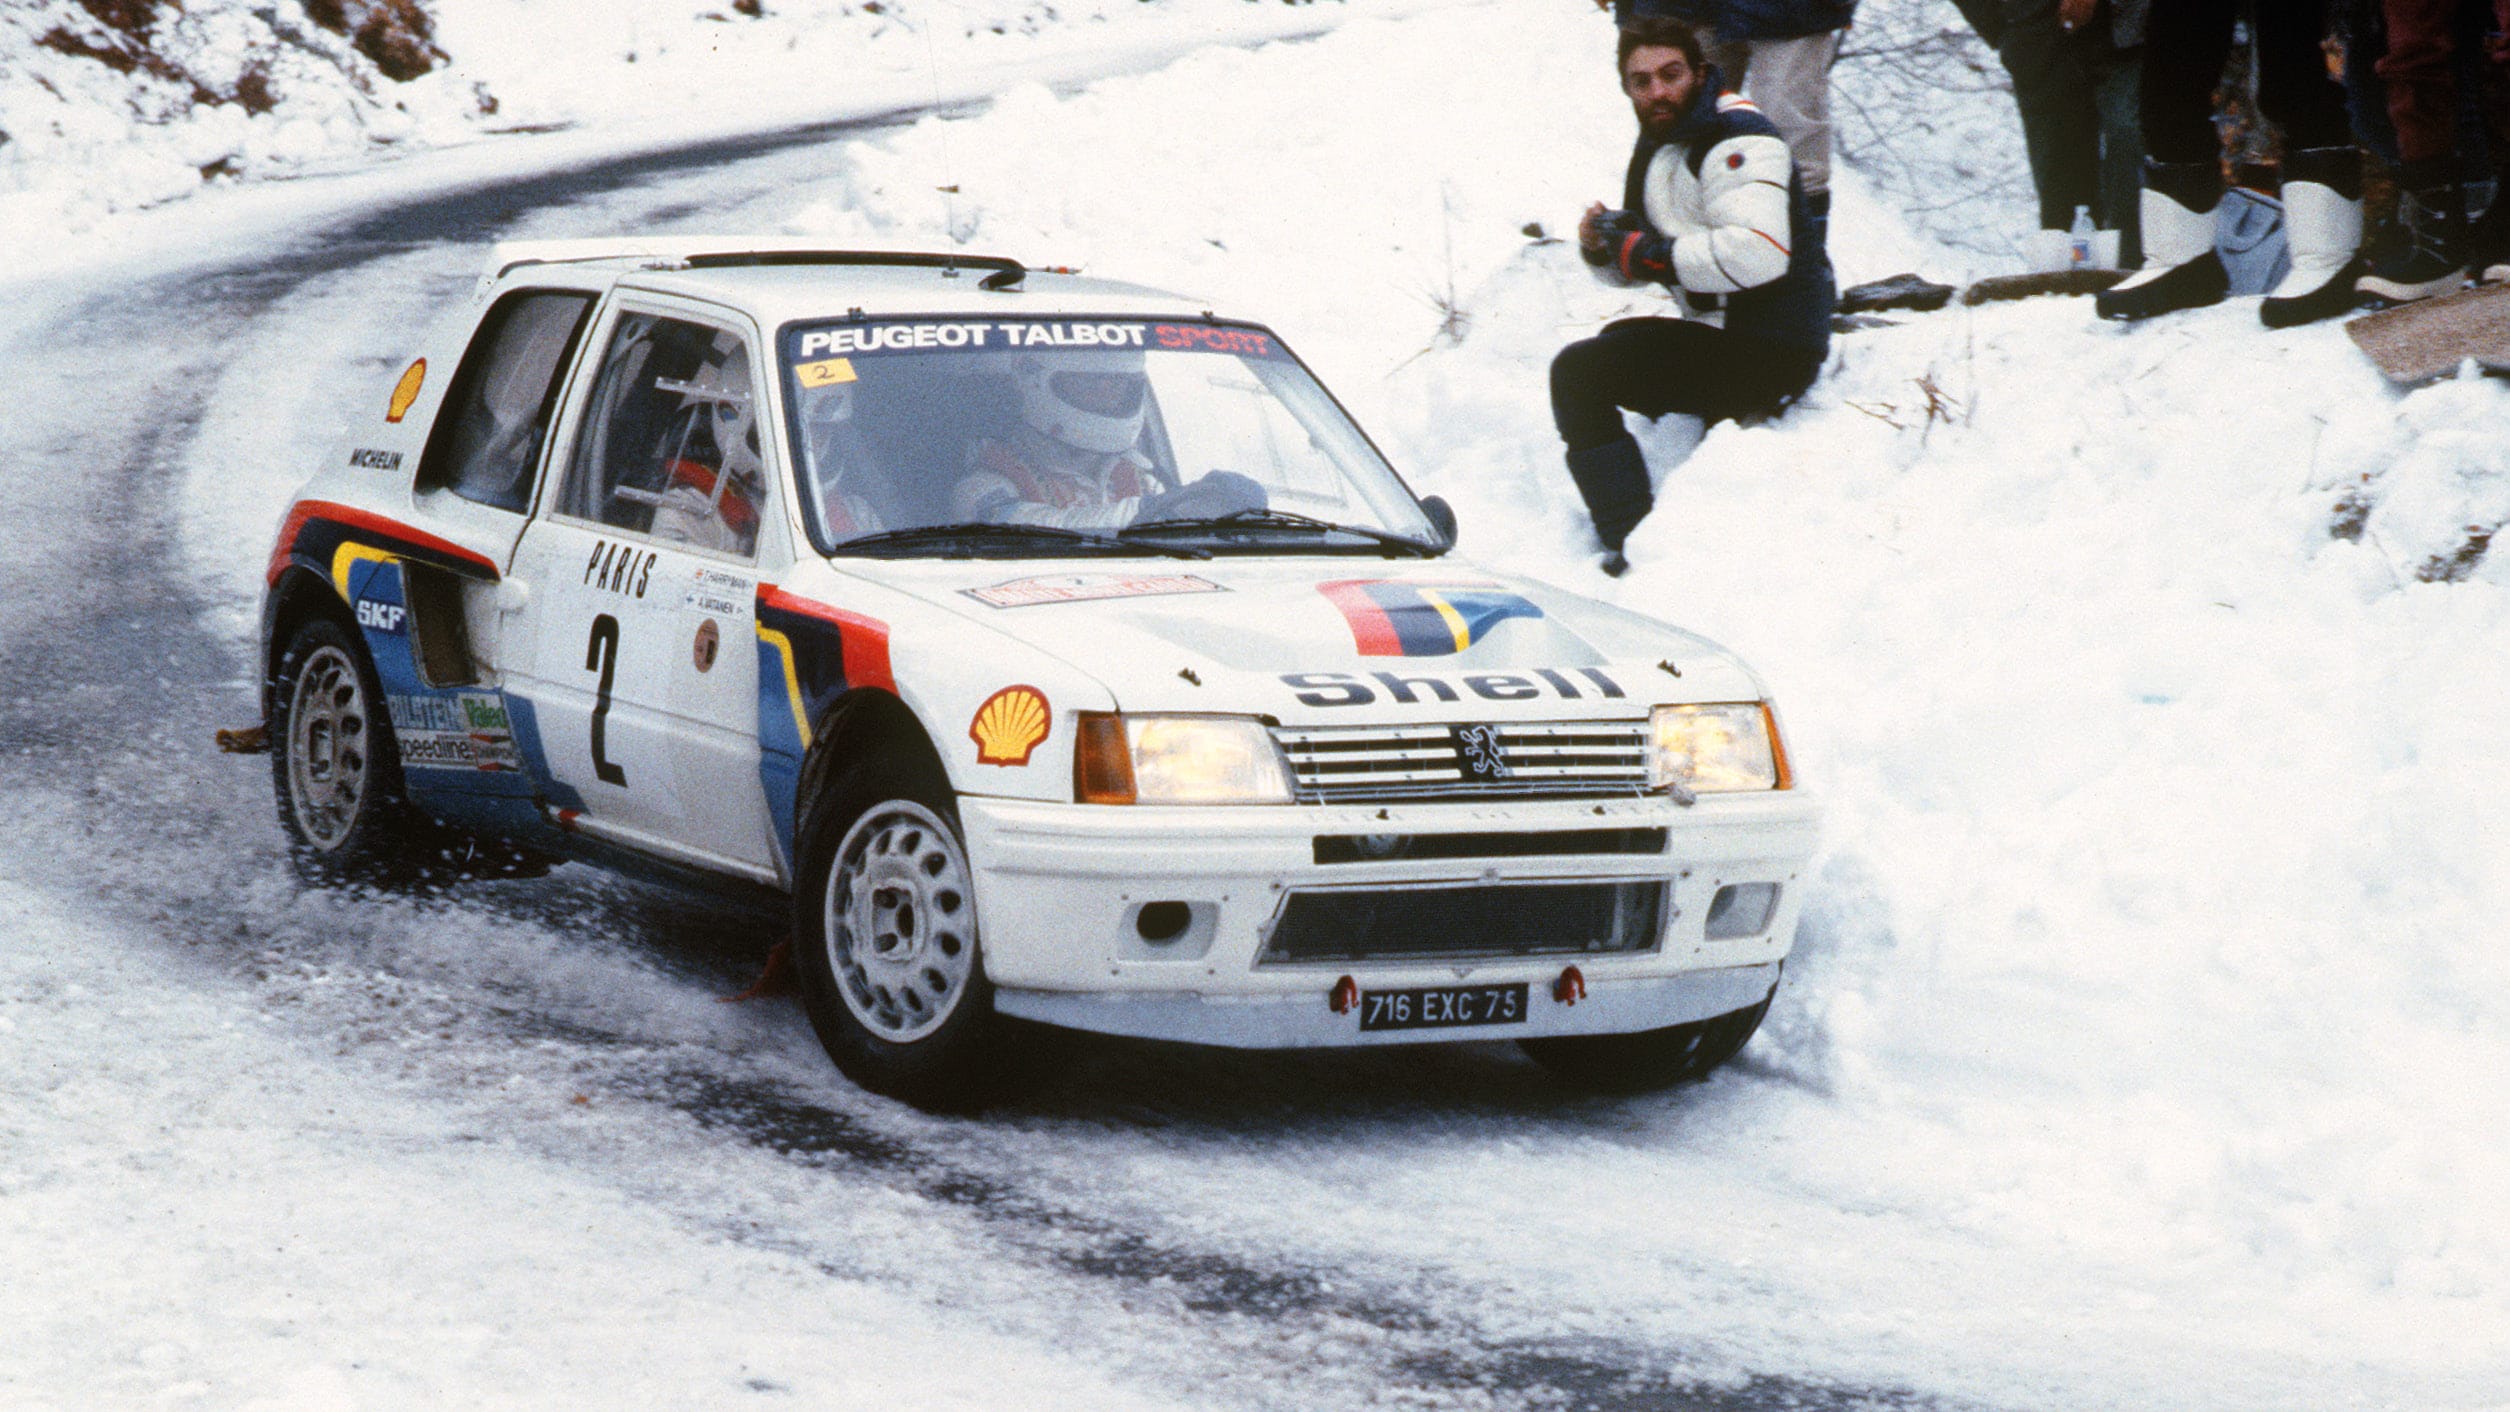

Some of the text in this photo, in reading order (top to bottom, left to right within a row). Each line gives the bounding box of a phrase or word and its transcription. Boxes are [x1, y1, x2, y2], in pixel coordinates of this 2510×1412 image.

[801, 323, 1268, 357] PEUGEOT TALBOT SPORT
[813, 364, 835, 380] 2
[348, 448, 404, 472] MICHELIN
[583, 539, 657, 599] PARIS
[357, 599, 405, 631] SKF
[585, 613, 628, 788] 2
[1278, 667, 1627, 708] Shell
[1368, 990, 1517, 1025] 716 EXC 75
